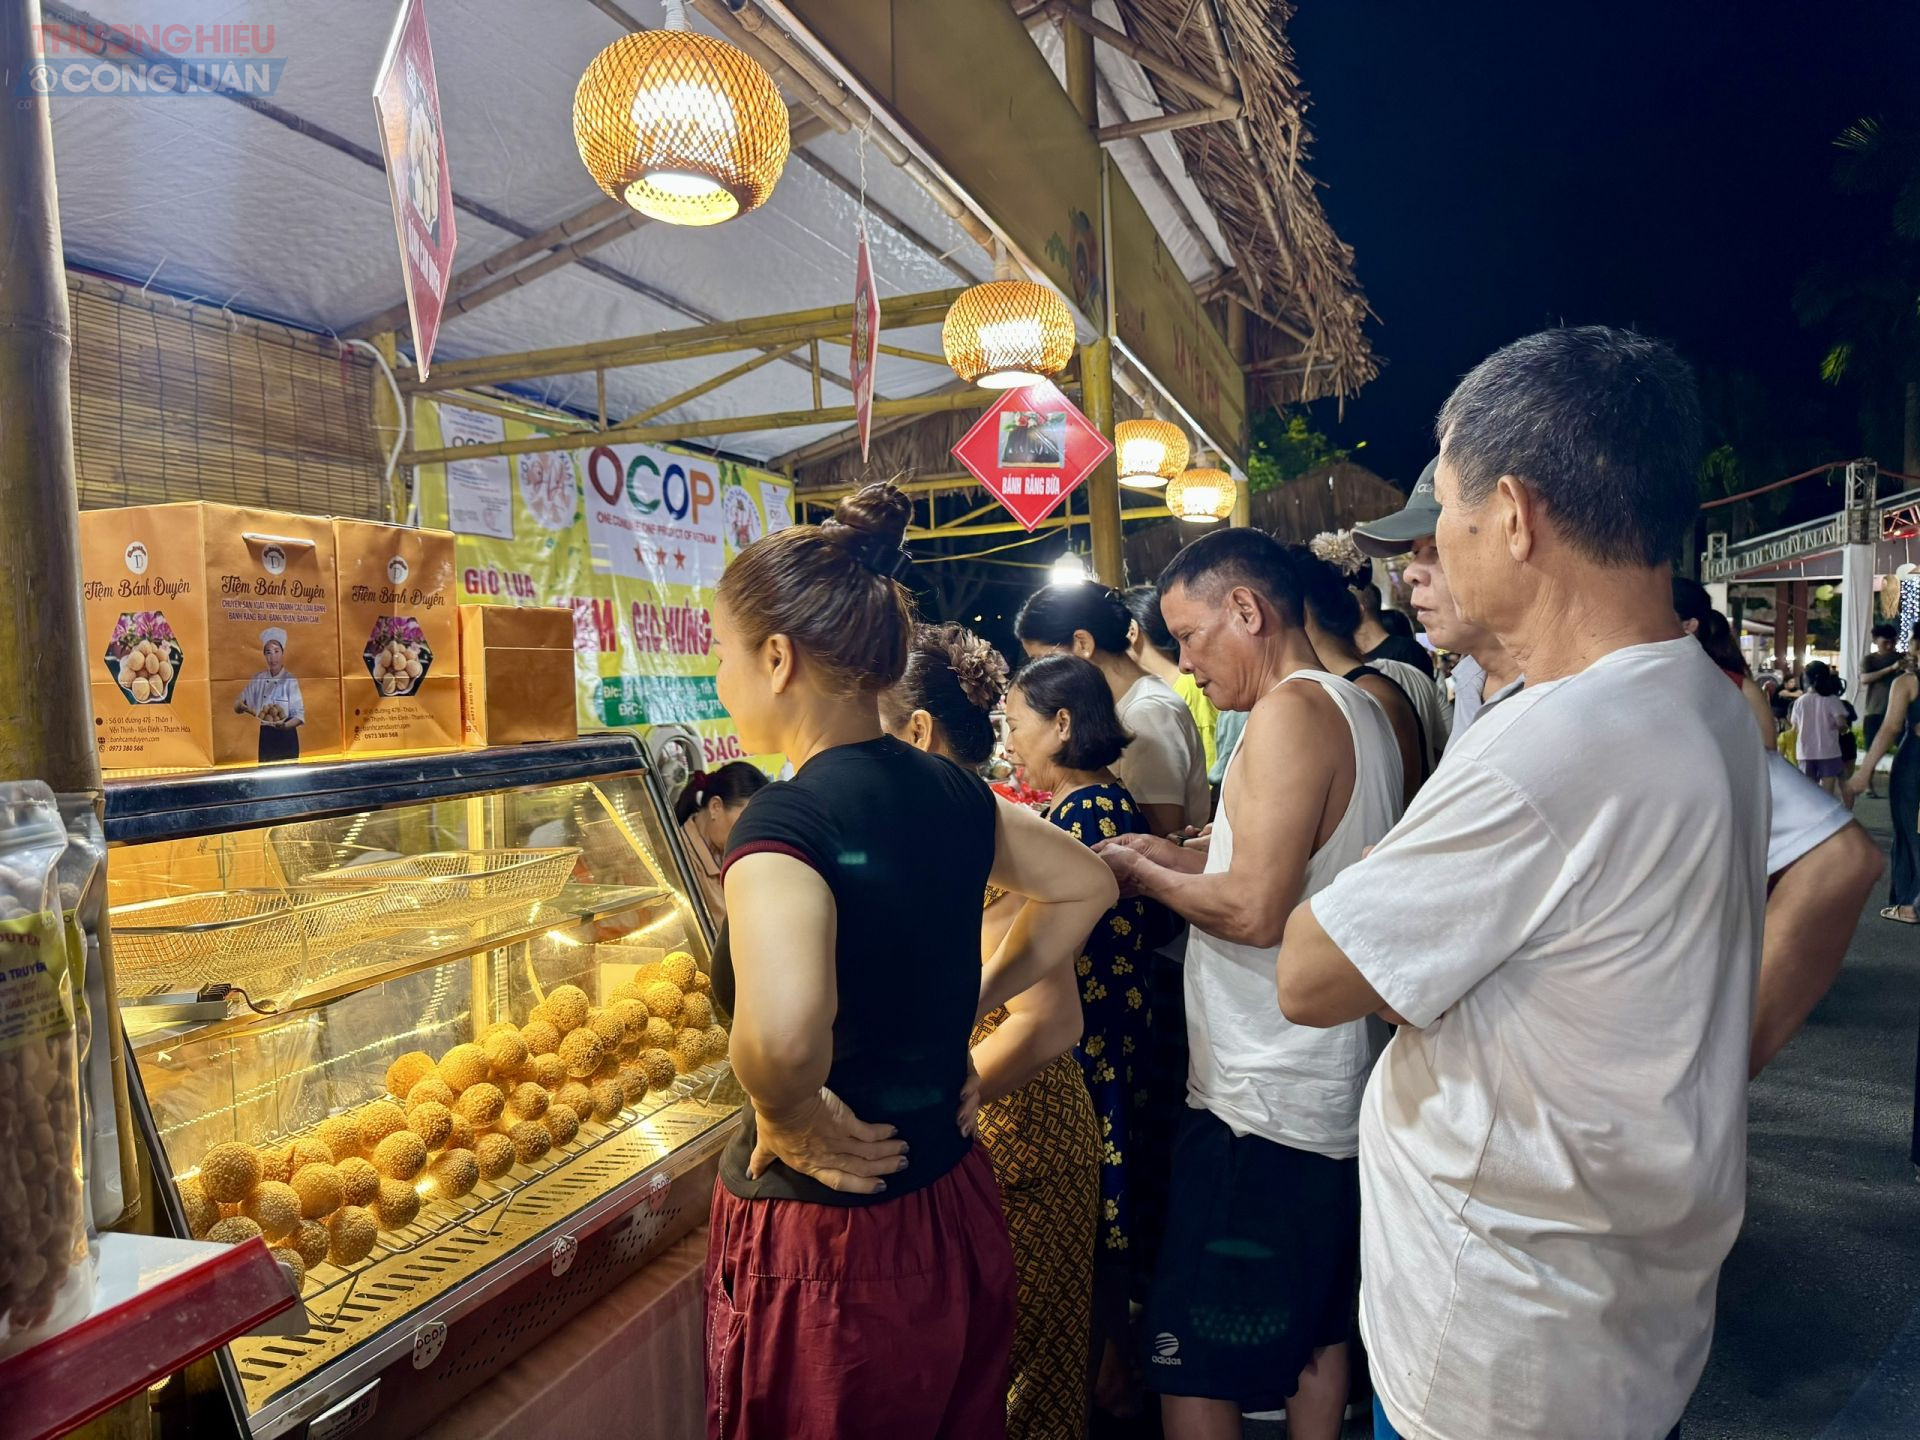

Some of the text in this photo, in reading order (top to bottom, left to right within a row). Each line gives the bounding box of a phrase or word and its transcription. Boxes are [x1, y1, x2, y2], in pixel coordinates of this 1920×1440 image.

[588, 445, 715, 525] OCOP
[1002, 473, 1022, 495] BÁNH
[84, 577, 192, 601] Tiệm Bánh Duyên
[221, 575, 251, 596] Tiệm
[254, 577, 287, 596] Bánh
[379, 586, 406, 604] Bánh
[416, 1324, 445, 1350] OCOP
